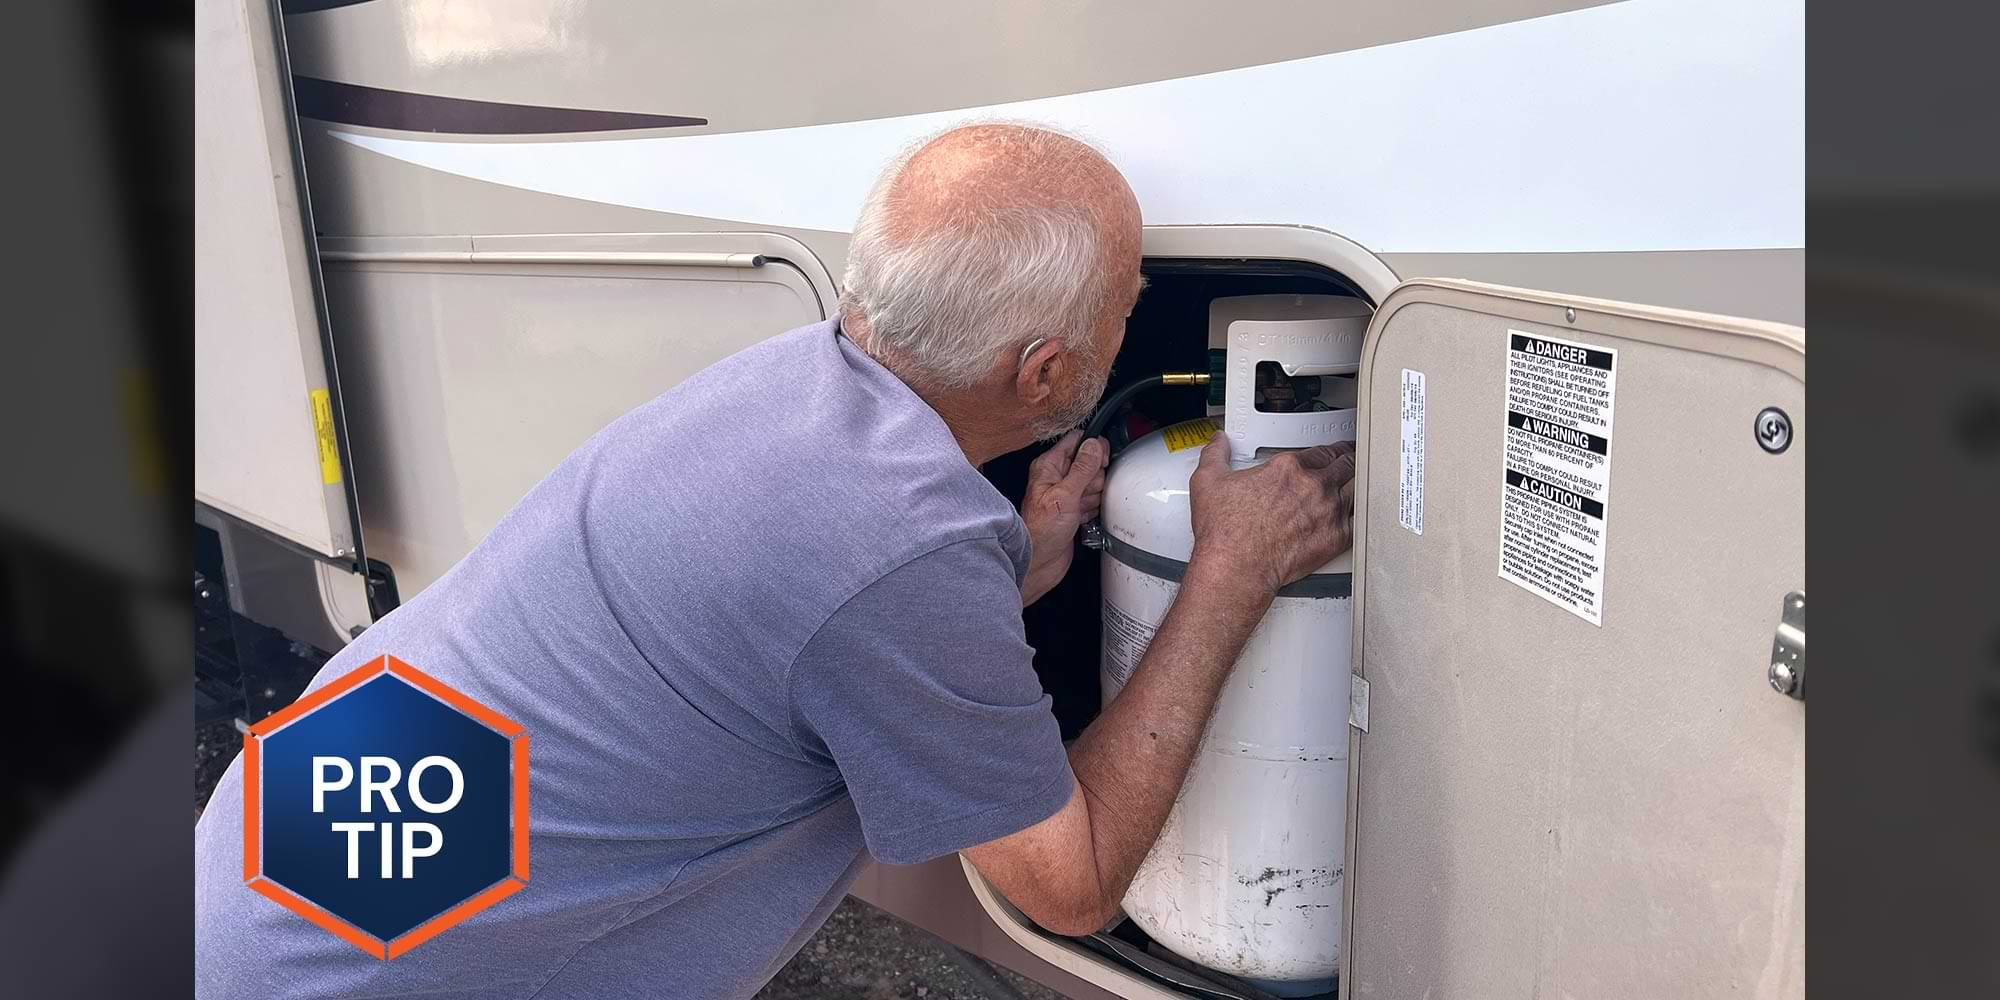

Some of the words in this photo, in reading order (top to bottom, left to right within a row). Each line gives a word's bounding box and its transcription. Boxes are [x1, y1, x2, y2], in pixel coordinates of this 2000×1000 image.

[1537, 341, 1587, 364] DANGER
[1511, 360, 1526, 368] THEIR
[1528, 364, 1553, 376] IGNITORS
[1555, 371, 1568, 380] (SEE
[1570, 374, 1606, 388] OPERATING
[1521, 354, 1535, 363] PILOT
[1558, 362, 1593, 376] APPLIANCES
[1595, 370, 1607, 379] AND
[1510, 378, 1530, 388] BEFORE
[1532, 383, 1562, 396] REFUELING
[1573, 393, 1588, 403] FUEL
[1588, 397, 1609, 408] TANKS
[1510, 386, 1530, 396] AND/OR
[1532, 392, 1558, 404] PROPANE
[1548, 378, 1564, 388] SHALL
[1566, 382, 1574, 390] BE
[1574, 384, 1597, 396] TURNED
[1598, 390, 1609, 398] OFF
[1509, 403, 1525, 412] DEATH
[1535, 410, 1558, 422] SERIOUS
[1510, 395, 1529, 405] FAILURE
[1537, 402, 1558, 413] COMPLY
[1559, 408, 1577, 418] COULD
[1578, 414, 1599, 424] RESULT
[1527, 434, 1537, 442] FILL
[1538, 437, 1563, 451] PROPANE
[1533, 419, 1589, 448] WARNING
[1516, 439, 1531, 449] MORE
[1533, 444, 1547, 454] THAN
[1556, 452, 1583, 466] PERCENT
[1507, 452, 1527, 465] FAILURE
[1536, 463, 1558, 474] COMPLY
[1559, 471, 1578, 482] COULD
[1580, 478, 1602, 490] RESULT
[1518, 464, 1531, 474] FIRE
[1531, 469, 1539, 477] OR
[1540, 472, 1571, 489] PERSONAL
[1506, 486, 1516, 495] THIS
[1517, 490, 1540, 505] PROPANE
[1541, 499, 1558, 512] PIPING
[1559, 507, 1581, 520] SYSTEM
[1531, 480, 1582, 510] CAUTION
[1505, 494, 1530, 509] DESIGNED
[1531, 504, 1542, 514] FOR
[1543, 509, 1554, 519] USE
[1555, 514, 1570, 525] WITH
[1571, 521, 1599, 538] PROPANE
[1505, 511, 1515, 519] GAS
[1524, 518, 1535, 528] THIS
[1522, 509, 1529, 517] DO
[1530, 514, 1541, 522] NOT
[1542, 518, 1569, 533] CONNECT
[1570, 529, 1597, 546] NATURAL
